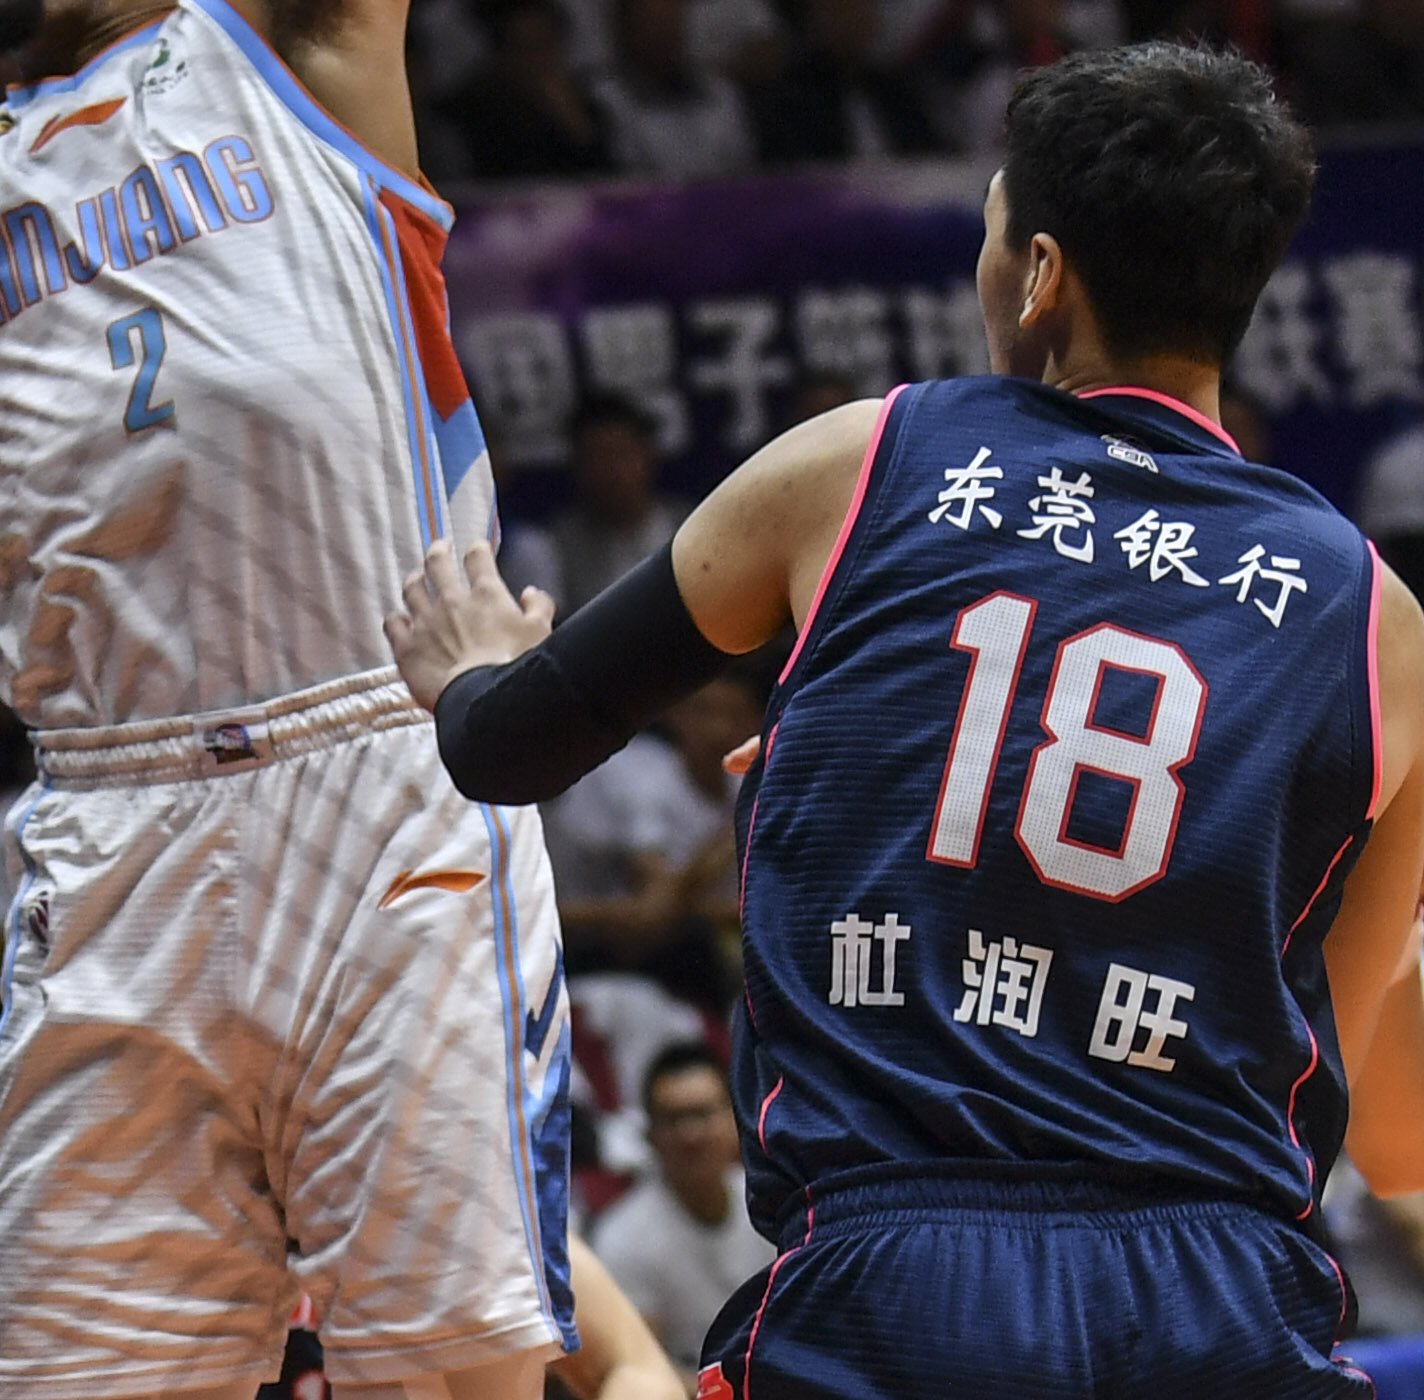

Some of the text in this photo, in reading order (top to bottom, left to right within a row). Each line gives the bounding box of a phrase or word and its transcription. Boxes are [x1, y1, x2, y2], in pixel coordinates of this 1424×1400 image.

[104, 306, 177, 435] 2
[927, 446, 1307, 627] 东莞银行
[925, 589, 1208, 904] 18
[827, 911, 1196, 1073] 杜润旺
